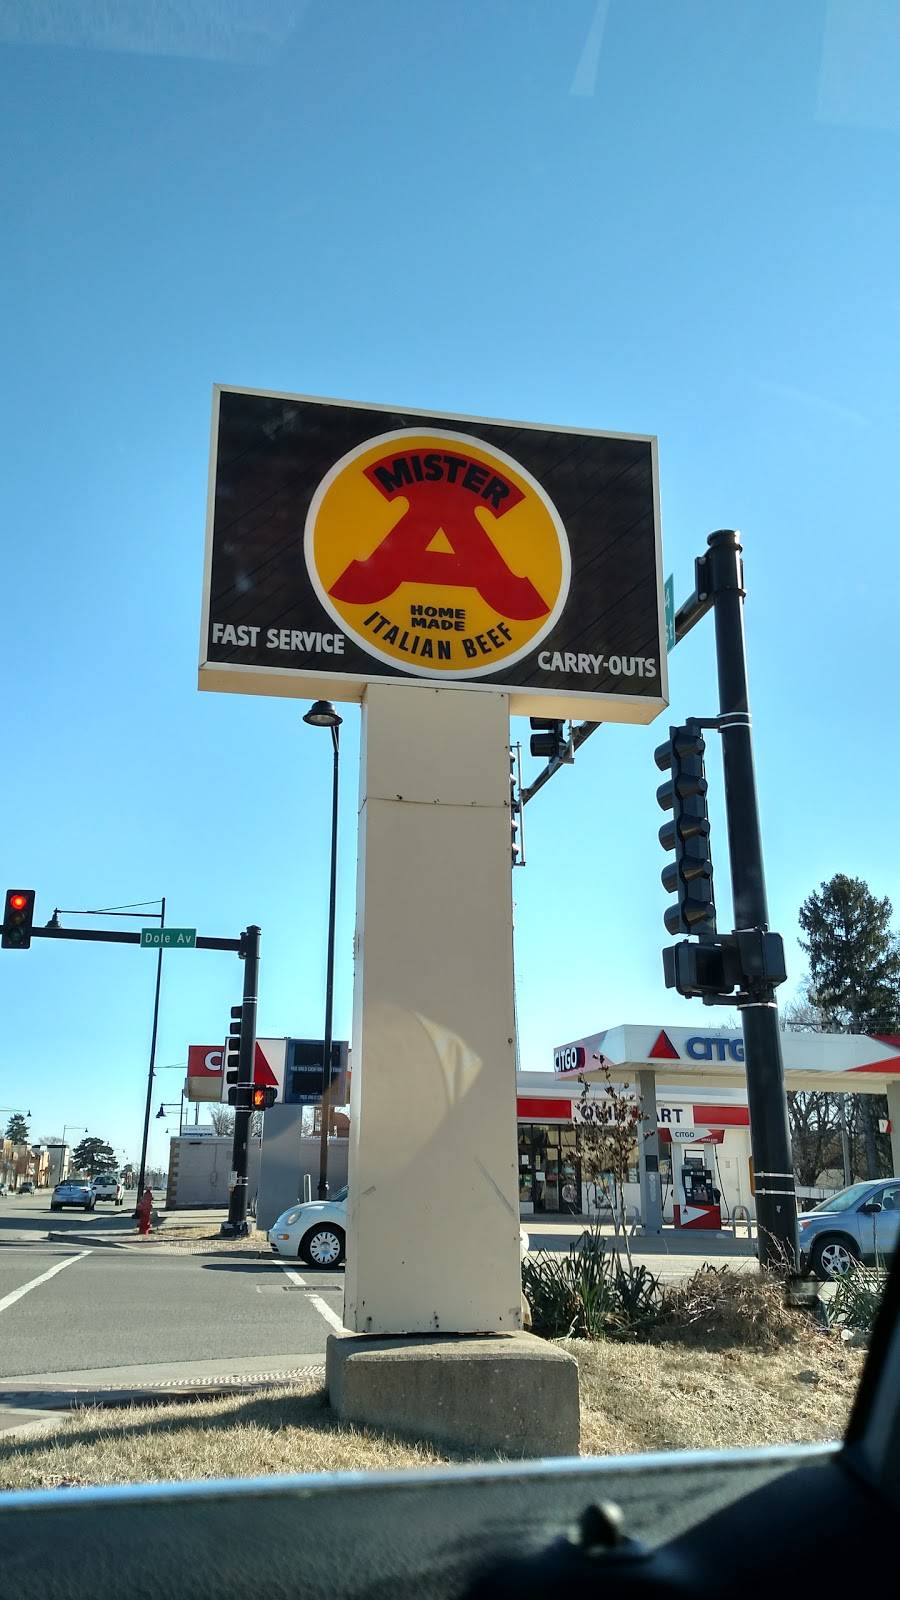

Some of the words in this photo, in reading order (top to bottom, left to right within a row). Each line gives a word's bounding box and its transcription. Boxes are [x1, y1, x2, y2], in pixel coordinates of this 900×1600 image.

[373, 454, 510, 510] MISTER
[329, 452, 550, 621] A
[410, 605, 466, 620] HOME
[410, 617, 466, 631] MADE
[212, 622, 261, 648] FAST
[265, 628, 345, 655] SERVICE
[363, 611, 451, 660] ITALIAN
[461, 621, 513, 659] BEEF
[537, 650, 657, 678] CARRY-OUTS
[145, 933, 171, 943] Dole
[176, 933, 192, 943] Av
[554, 1047, 577, 1072] CITGO
[686, 1037, 745, 1062] CITG
